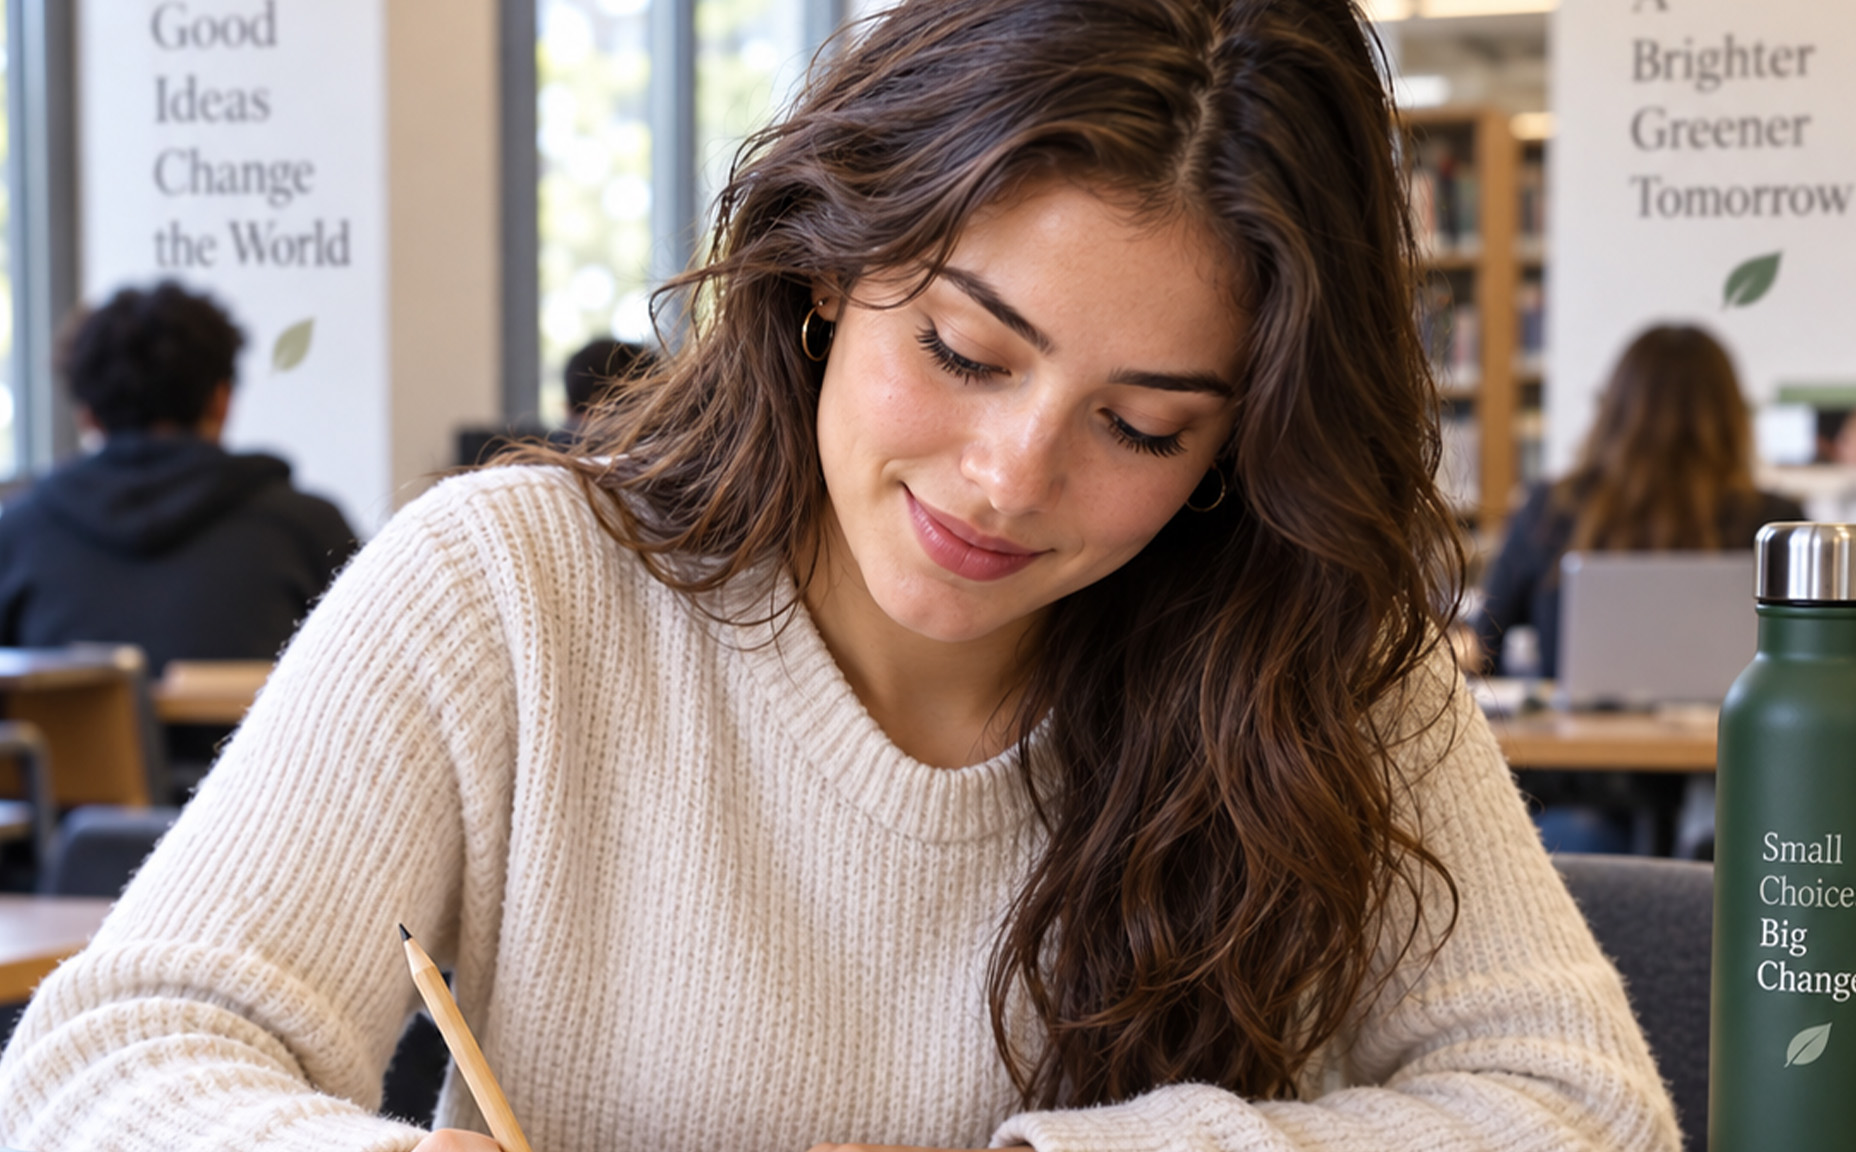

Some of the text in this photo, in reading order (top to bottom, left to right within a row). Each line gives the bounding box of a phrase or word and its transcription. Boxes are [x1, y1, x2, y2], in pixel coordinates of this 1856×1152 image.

[151, 0, 278, 50] Good
[1632, 33, 1816, 94] Brighter
[155, 75, 271, 125] Ideas
[1630, 105, 1812, 152] Greener
[154, 147, 315, 207] Change
[1631, 176, 1855, 219] Tomorrow
[154, 219, 351, 269] the World
[1762, 831, 1843, 864] Small
[1759, 875, 1856, 908] Choice
[1760, 918, 1807, 957] Big
